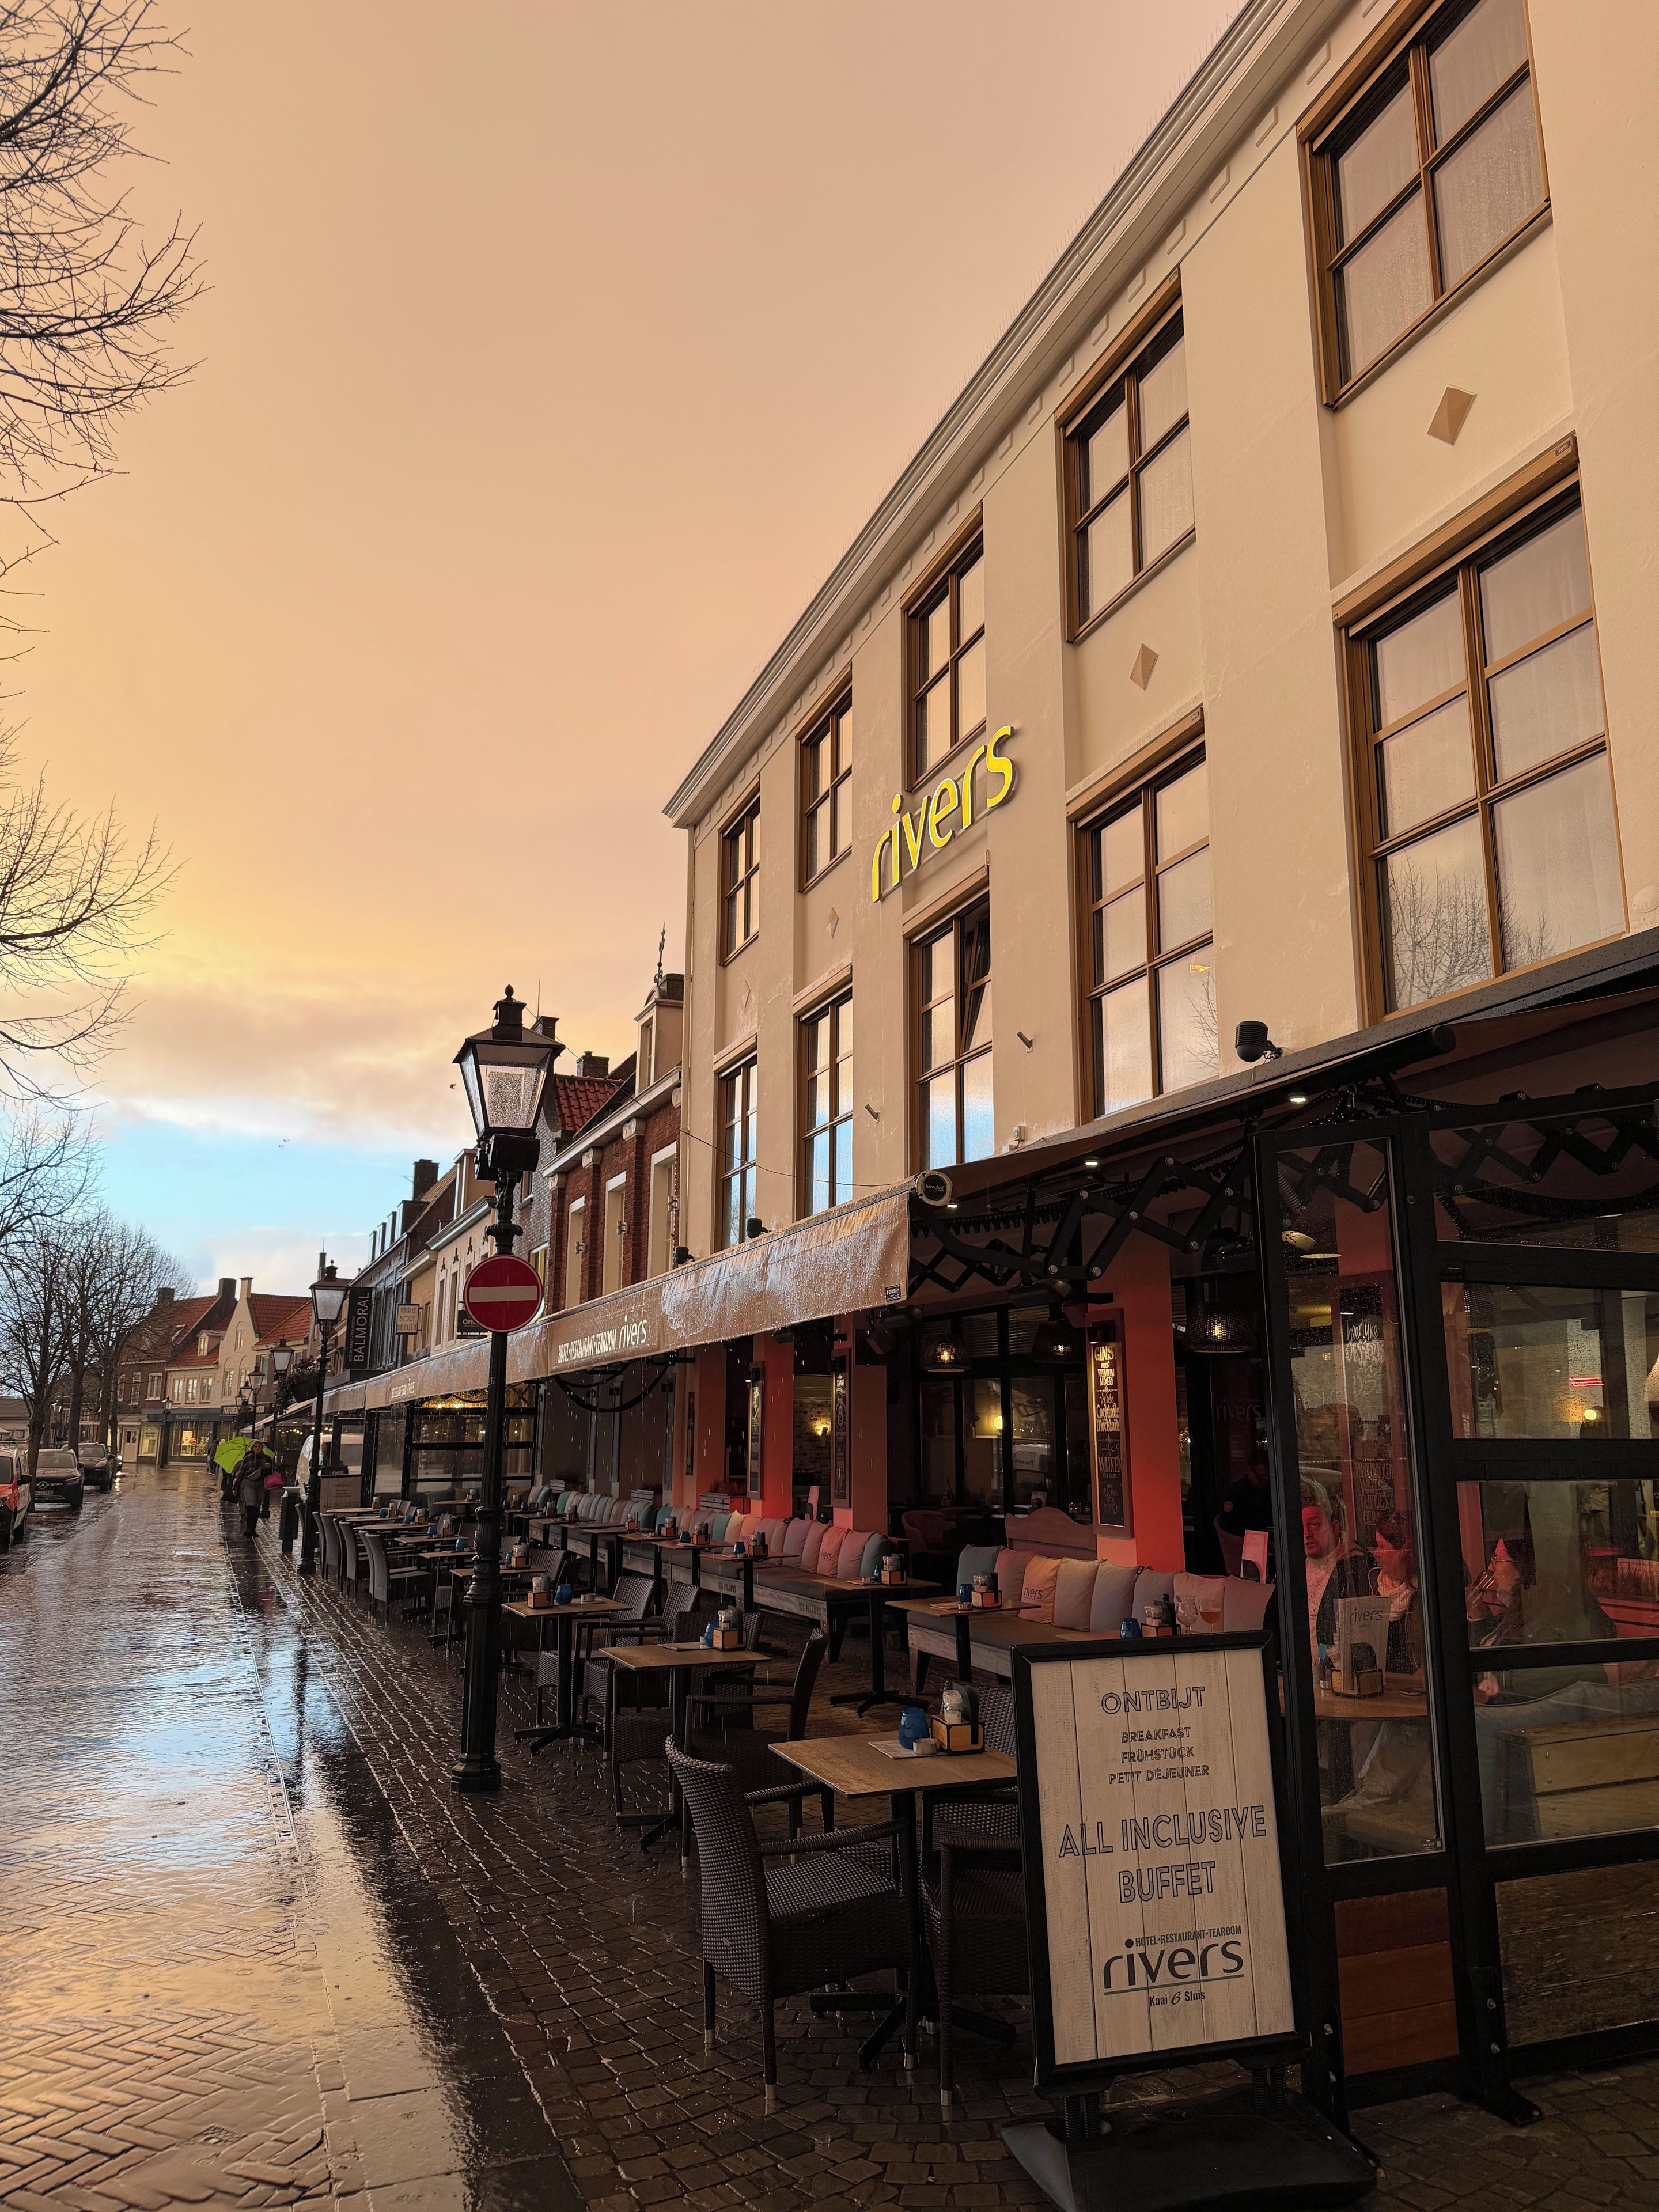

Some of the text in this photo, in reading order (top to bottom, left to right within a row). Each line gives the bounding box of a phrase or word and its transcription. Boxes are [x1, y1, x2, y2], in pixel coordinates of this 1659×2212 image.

[872, 725, 1015, 903] rivers
[353, 1293, 369, 1362] BALMORAL
[619, 1315, 647, 1349] rivers
[1217, 1397, 1262, 1421] rivers
[1024, 1583, 1043, 1600] rivers
[1350, 1605, 1383, 1623] rivers
[1101, 1686, 1205, 1714] ONTBIJT
[1121, 1726, 1191, 1743] BREAKFAST
[1121, 1746, 1195, 1763] FRÜHSTÜCK
[1109, 1770, 1142, 1784] PETIT
[1059, 1805, 1267, 1858] ALL INCLUSIVE
[1118, 1861, 1216, 1903] BUFFET
[1103, 1938, 1244, 1989] rivers
[1150, 1990, 1206, 2006] Kaai 6 Sluis
